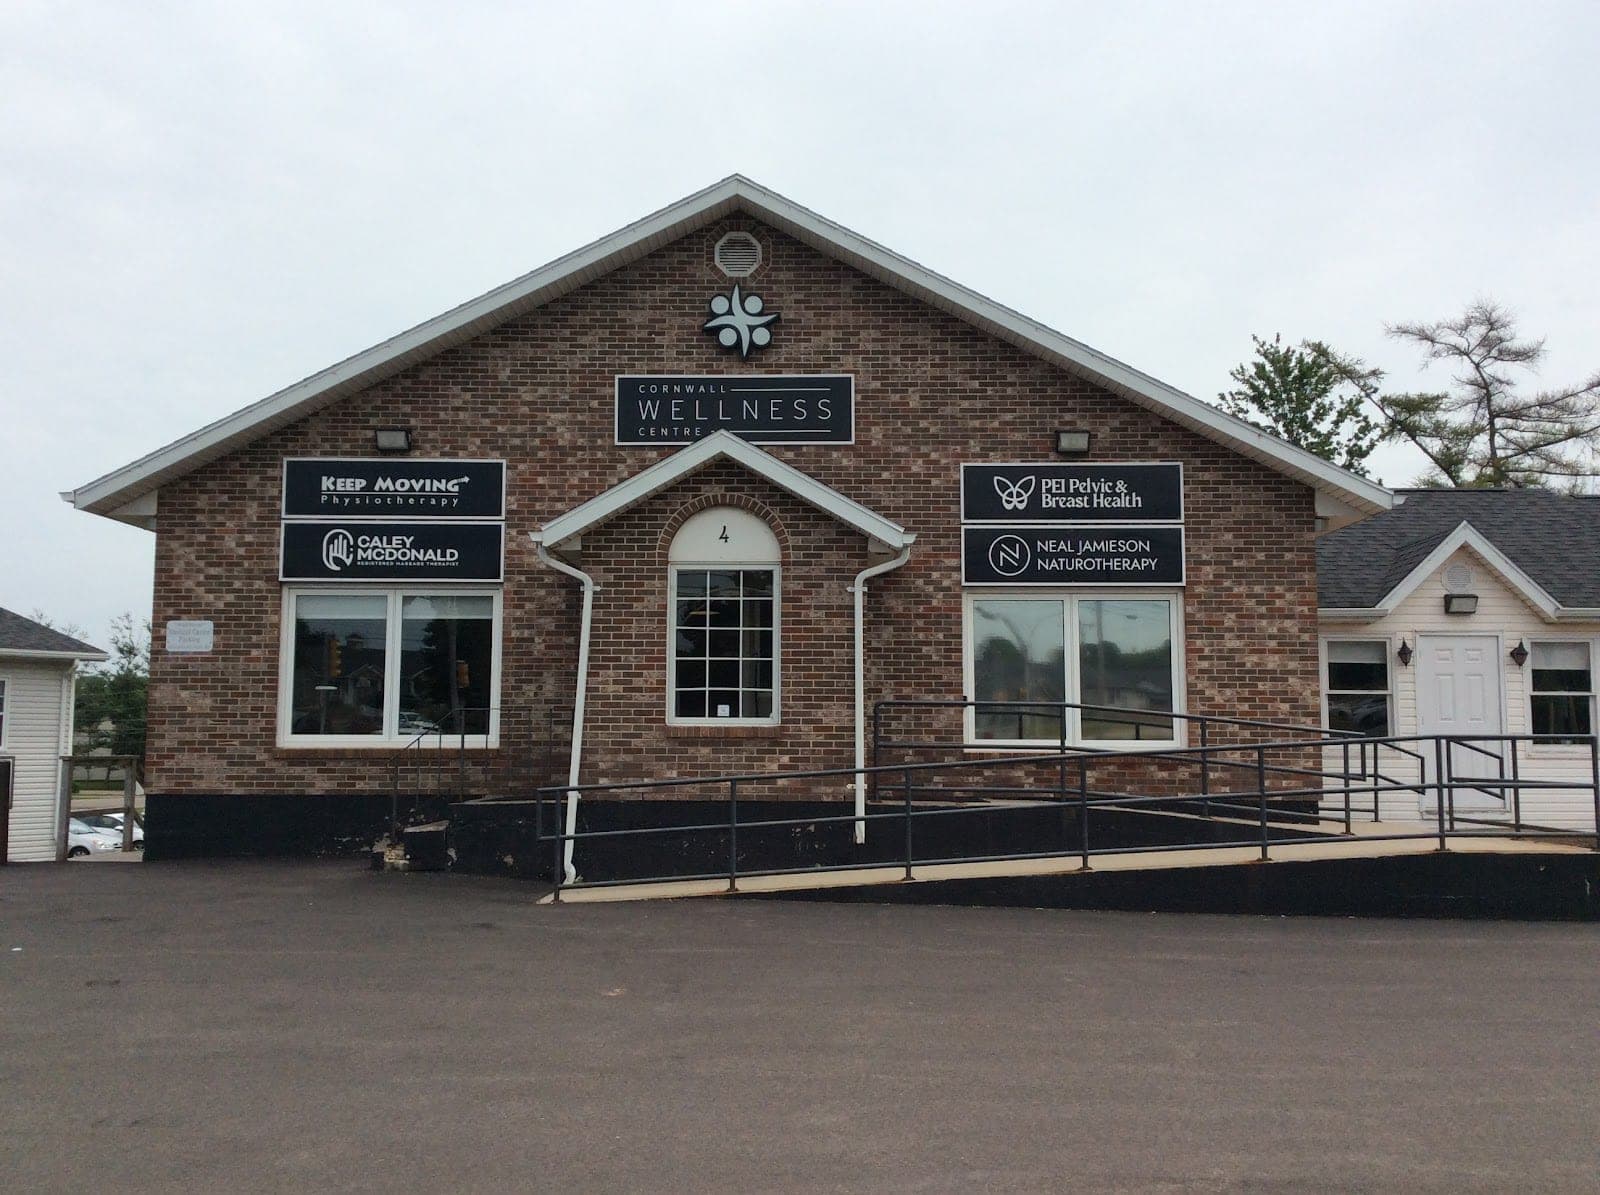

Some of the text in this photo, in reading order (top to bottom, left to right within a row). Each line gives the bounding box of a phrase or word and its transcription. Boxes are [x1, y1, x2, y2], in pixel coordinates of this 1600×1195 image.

[638, 384, 726, 394] CORNWALL
[638, 399, 832, 420] WELLNESS
[638, 427, 702, 436] CENTRE
[321, 476, 460, 492] KEEP MOVING
[1041, 477, 1128, 495] PEI Pelvic &
[320, 495, 459, 507] Physiotherapy
[1041, 492, 1143, 508] Breast Health
[719, 525, 730, 543] 4
[357, 535, 415, 548] CALEY
[1037, 540, 1150, 555] NEAL JAMIESON
[357, 549, 459, 562] MCDONALD
[1037, 558, 1159, 571] NATUROTHERAPY
